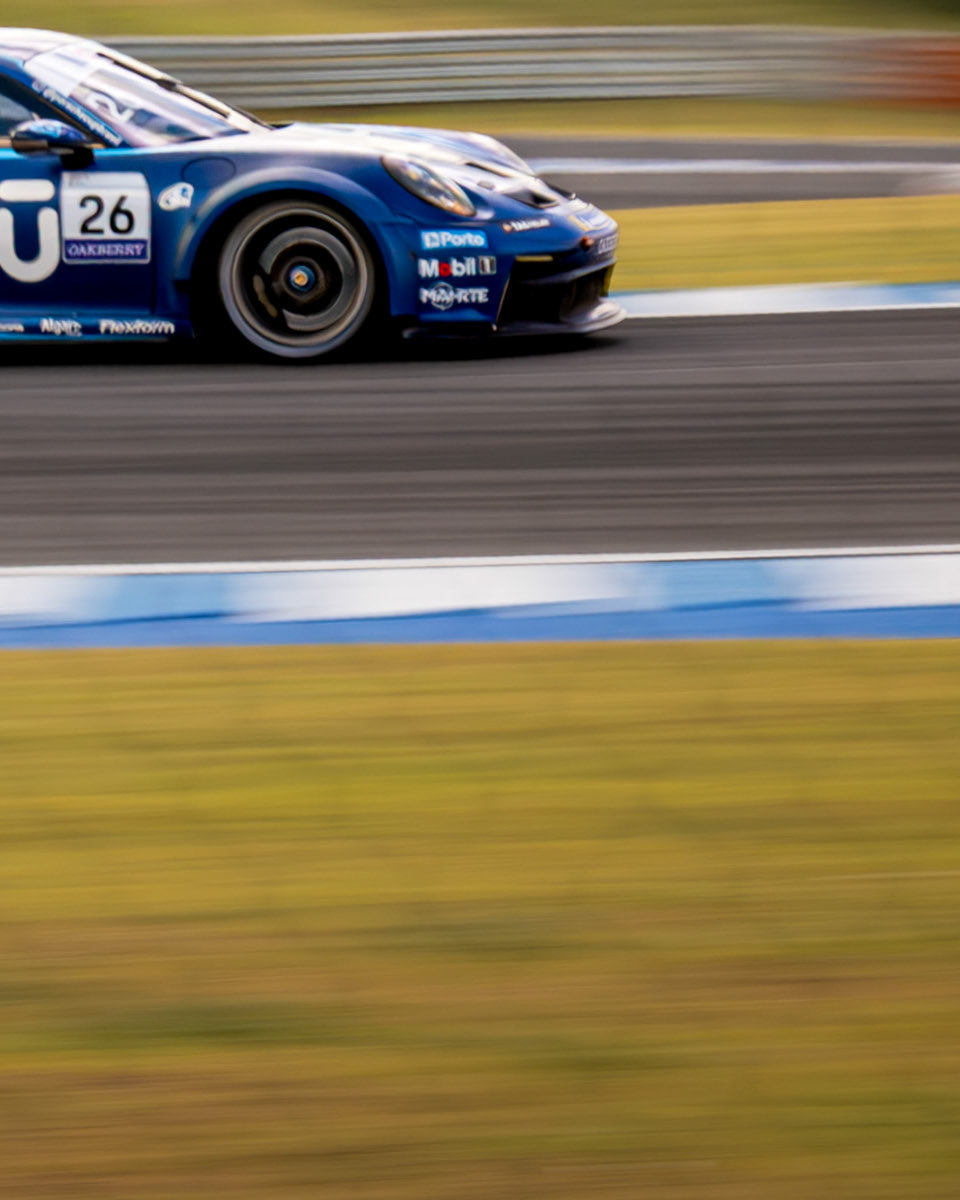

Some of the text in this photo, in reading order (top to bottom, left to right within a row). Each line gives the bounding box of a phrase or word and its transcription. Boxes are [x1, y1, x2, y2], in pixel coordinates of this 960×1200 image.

[79, 195, 134, 235] 26
[440, 231, 485, 247] Porto
[67, 242, 145, 257] OAKBERRY
[418, 256, 476, 278] Mobil
[99, 318, 175, 334] Flexform
